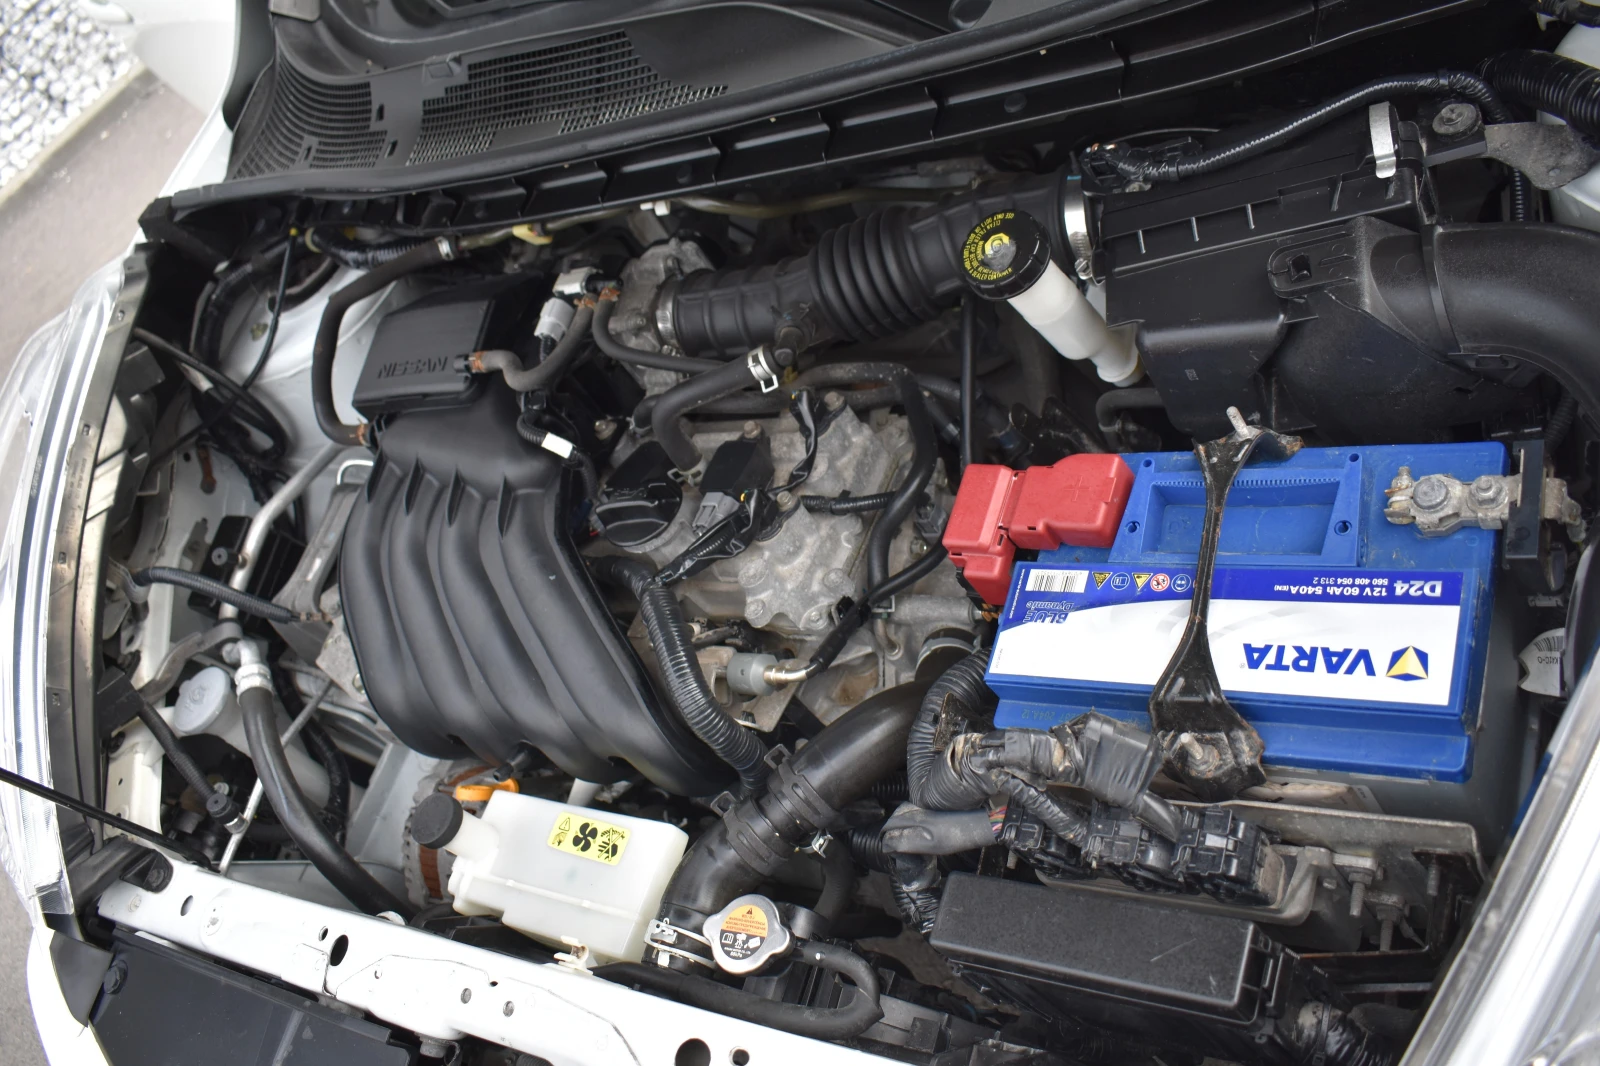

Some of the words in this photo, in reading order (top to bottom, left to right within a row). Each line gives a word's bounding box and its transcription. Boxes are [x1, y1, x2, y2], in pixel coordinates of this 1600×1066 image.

[986, 220, 1000, 230] CLEAN
[974, 229, 986, 242] FILLER
[376, 356, 449, 379] NISSAN
[1320, 577, 1336, 585] 313
[1337, 577, 1353, 585] 054
[1354, 577, 1371, 585] 408
[1372, 578, 1389, 586] 560
[1326, 586, 1360, 596] 60Ah
[1363, 586, 1388, 597] 12V
[1393, 580, 1443, 598] D24
[1026, 601, 1074, 612] Dynamic
[1022, 610, 1069, 624] BLUE
[1243, 643, 1377, 677] VARTA
